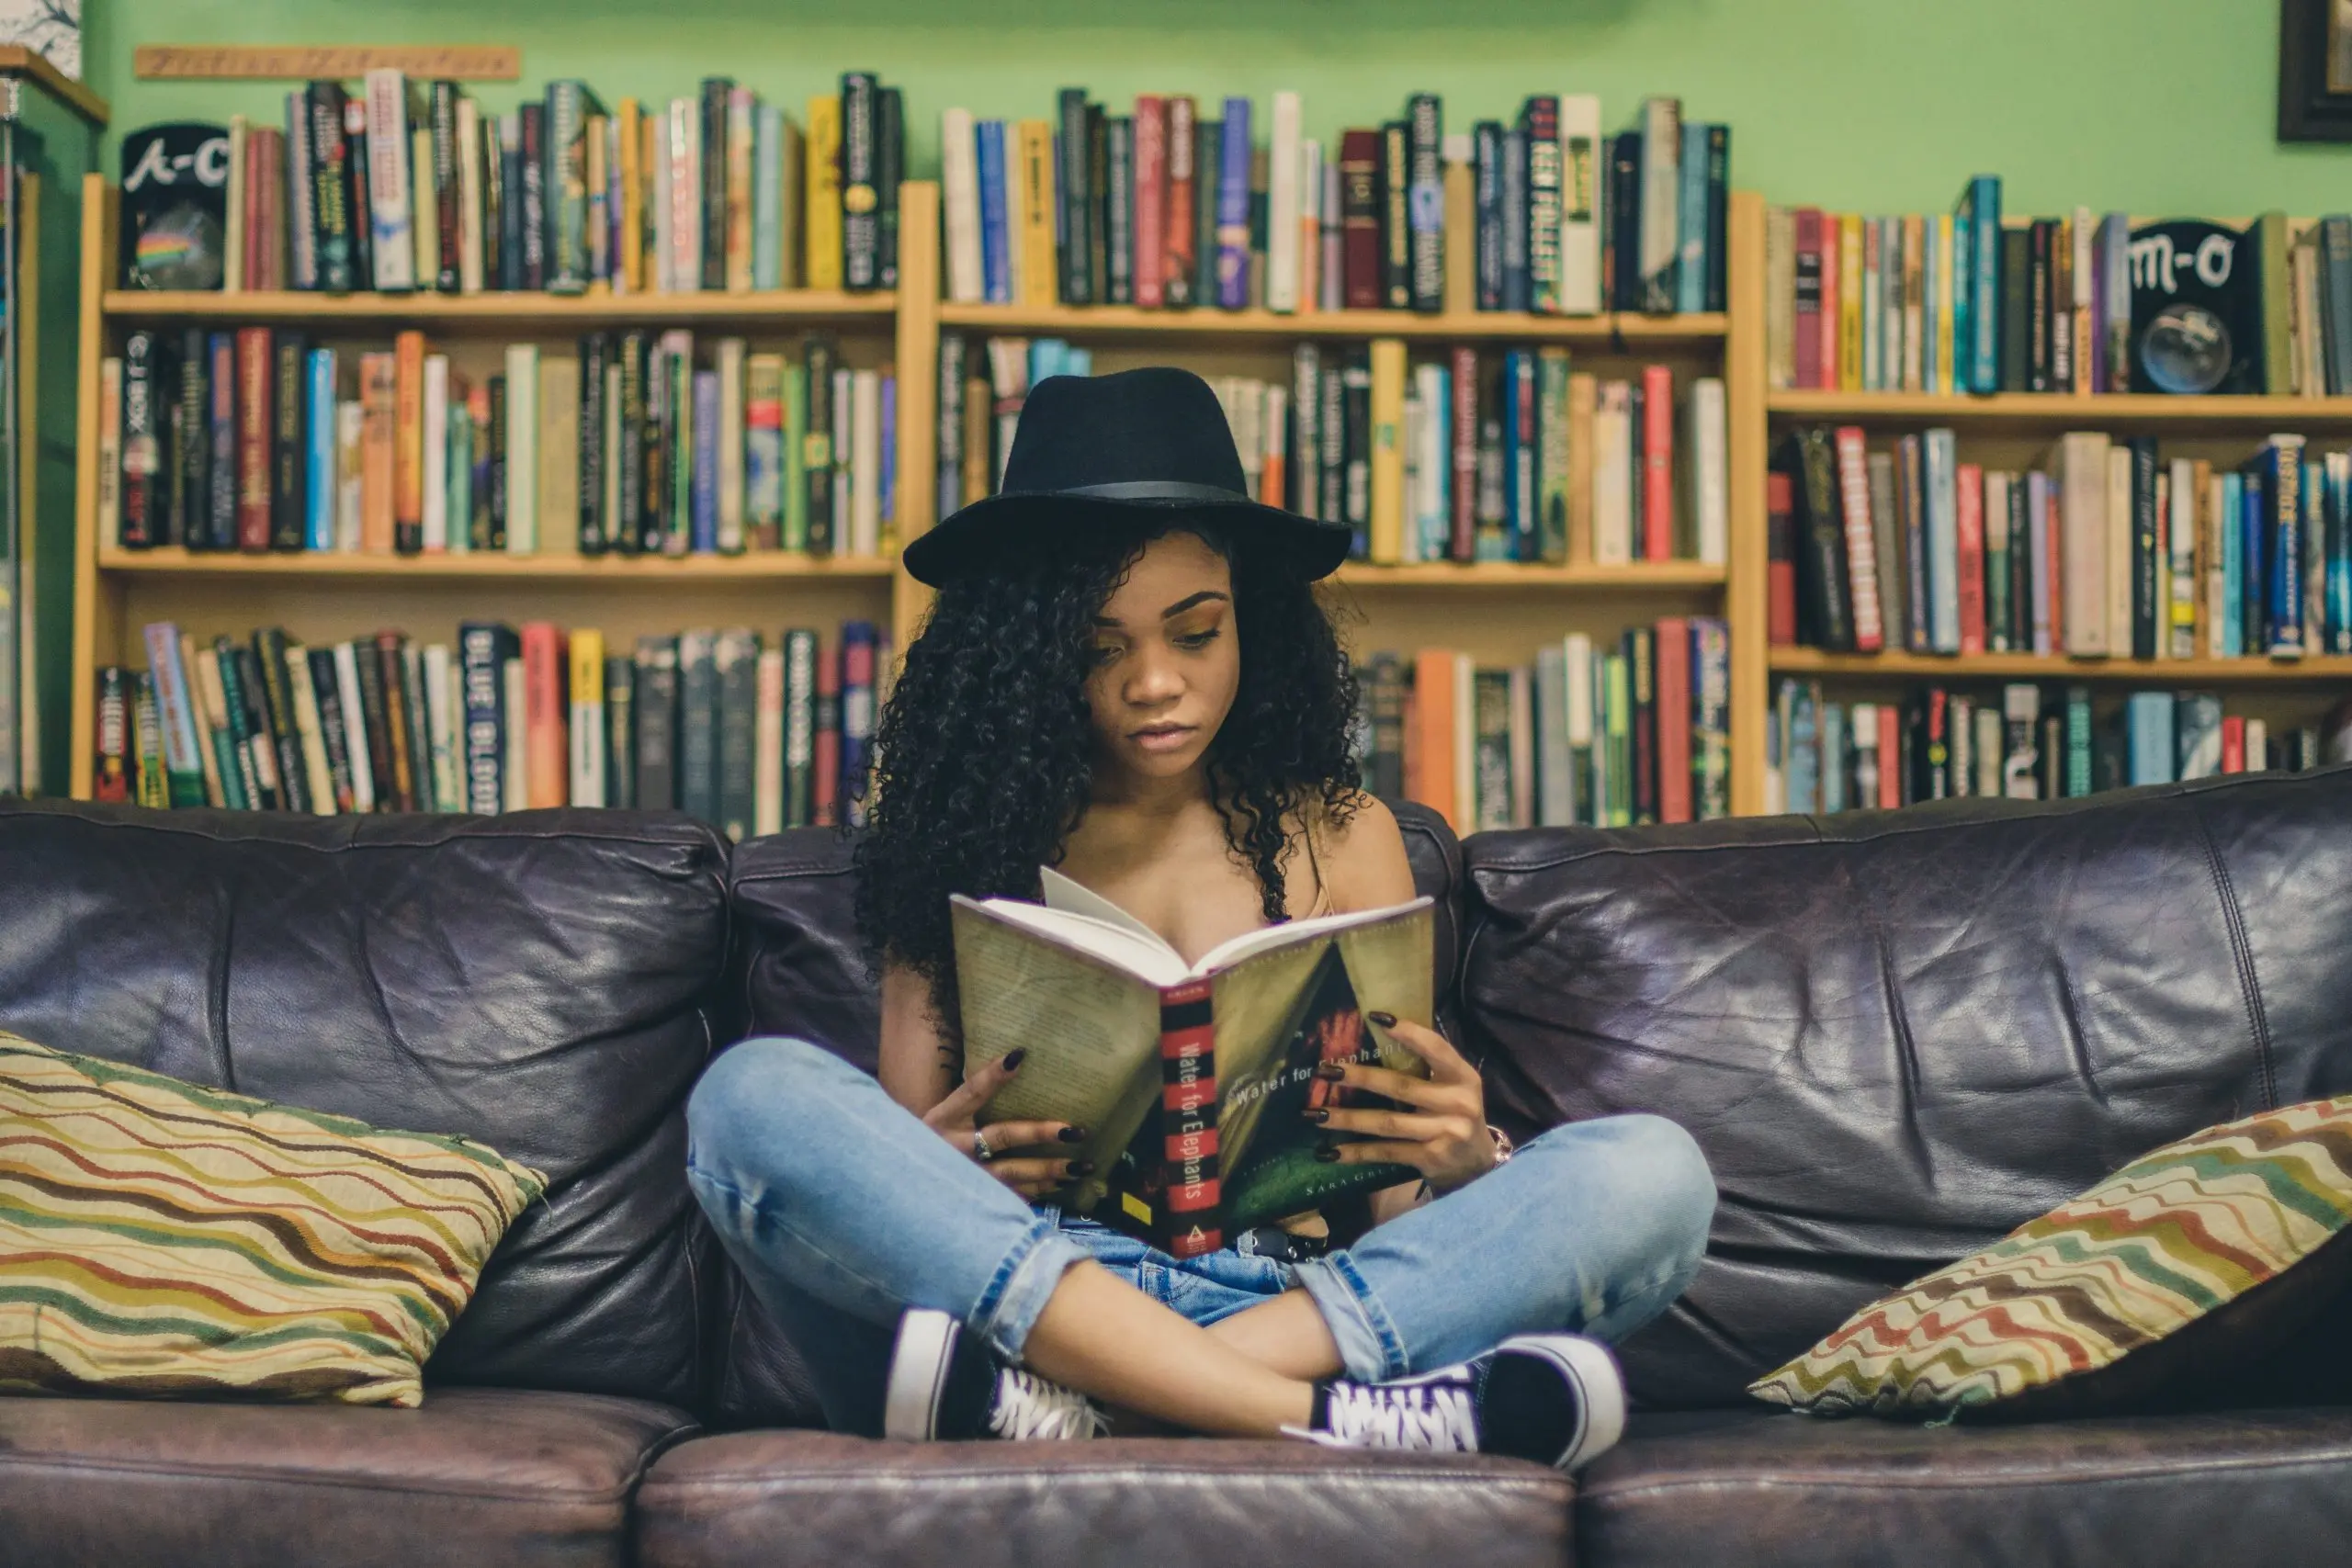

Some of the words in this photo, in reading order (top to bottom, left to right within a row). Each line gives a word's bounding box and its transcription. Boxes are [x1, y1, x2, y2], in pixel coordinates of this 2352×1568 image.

[1180, 1042, 1202, 1090] Water
[1237, 1074, 1287, 1106] Water
[1293, 1066, 1313, 1082] for
[1180, 1094, 1203, 1117] for
[1180, 1121, 1204, 1200] Elephants
